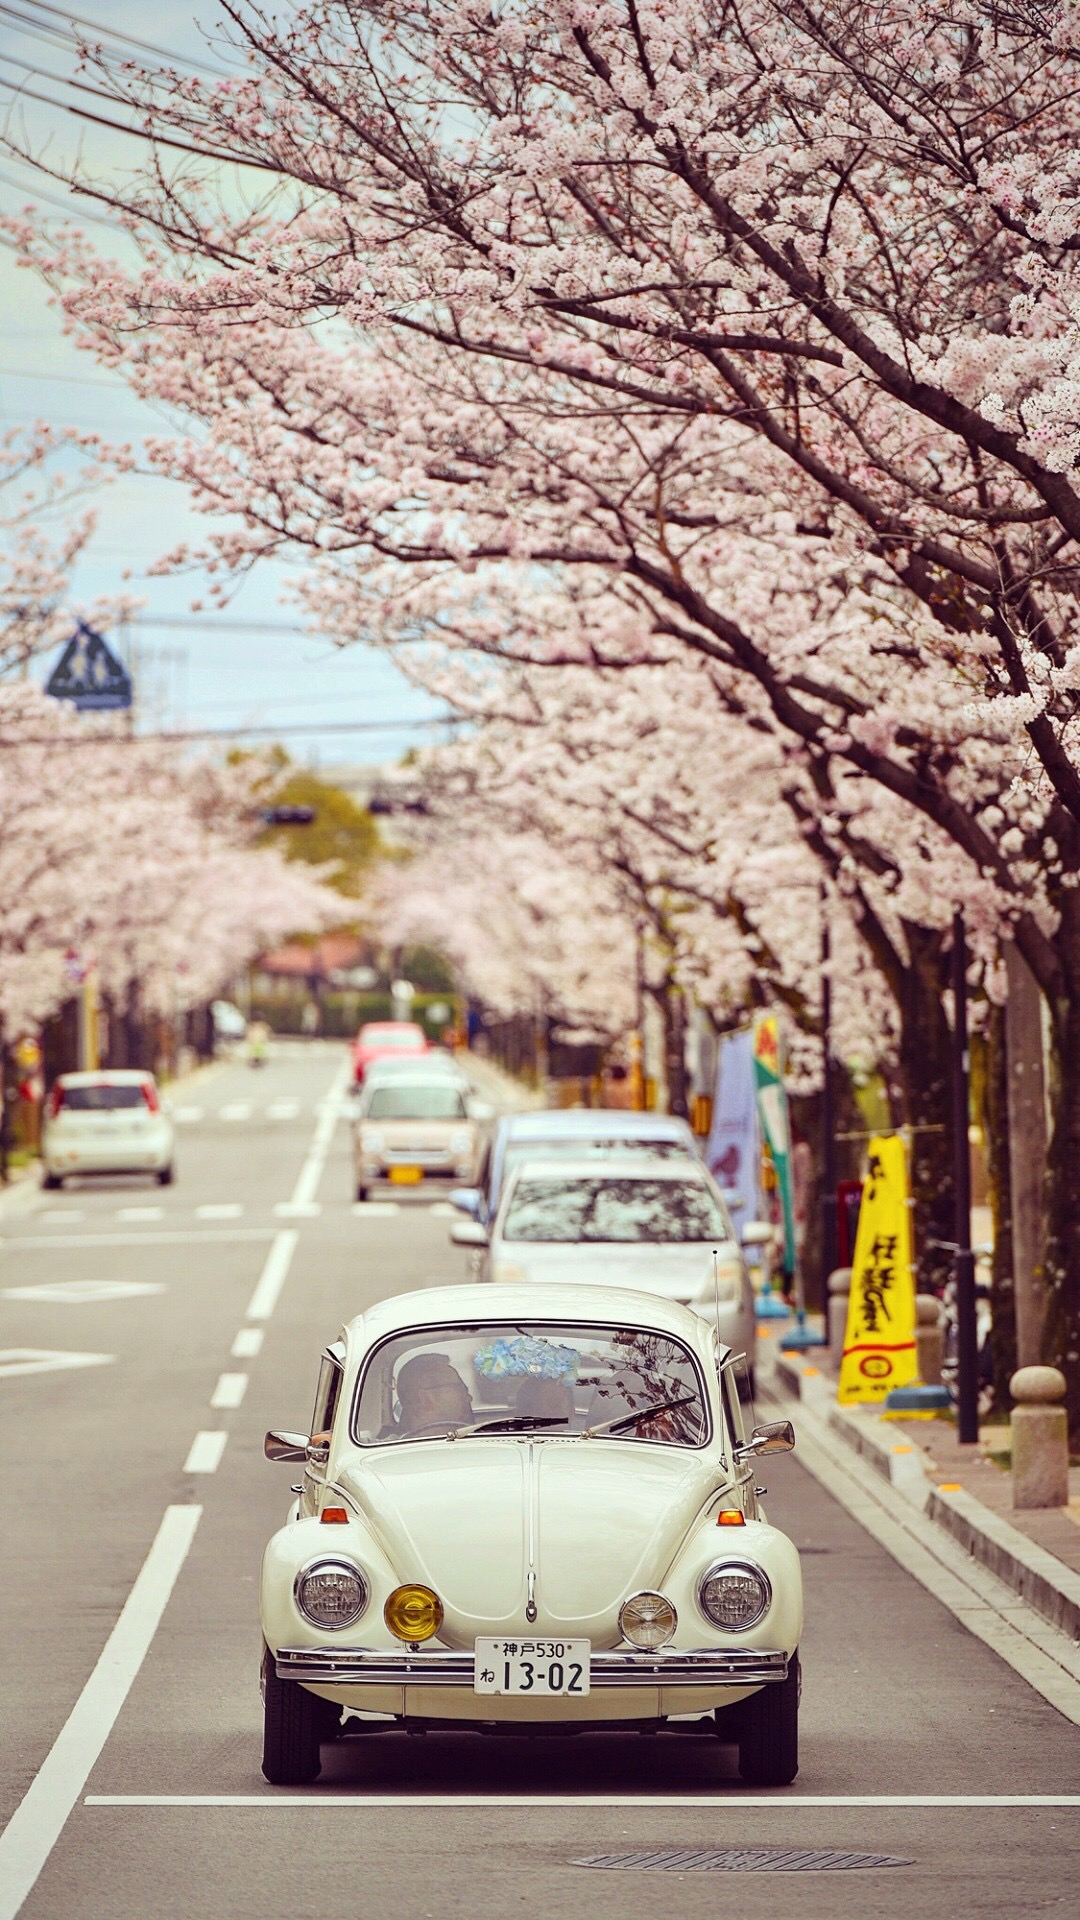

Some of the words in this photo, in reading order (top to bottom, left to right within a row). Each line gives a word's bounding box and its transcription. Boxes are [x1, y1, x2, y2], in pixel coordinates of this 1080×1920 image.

[502, 1642, 565, 1659] 神戸530
[479, 1668, 495, 1683] ね
[504, 1661, 583, 1692] 13-02
